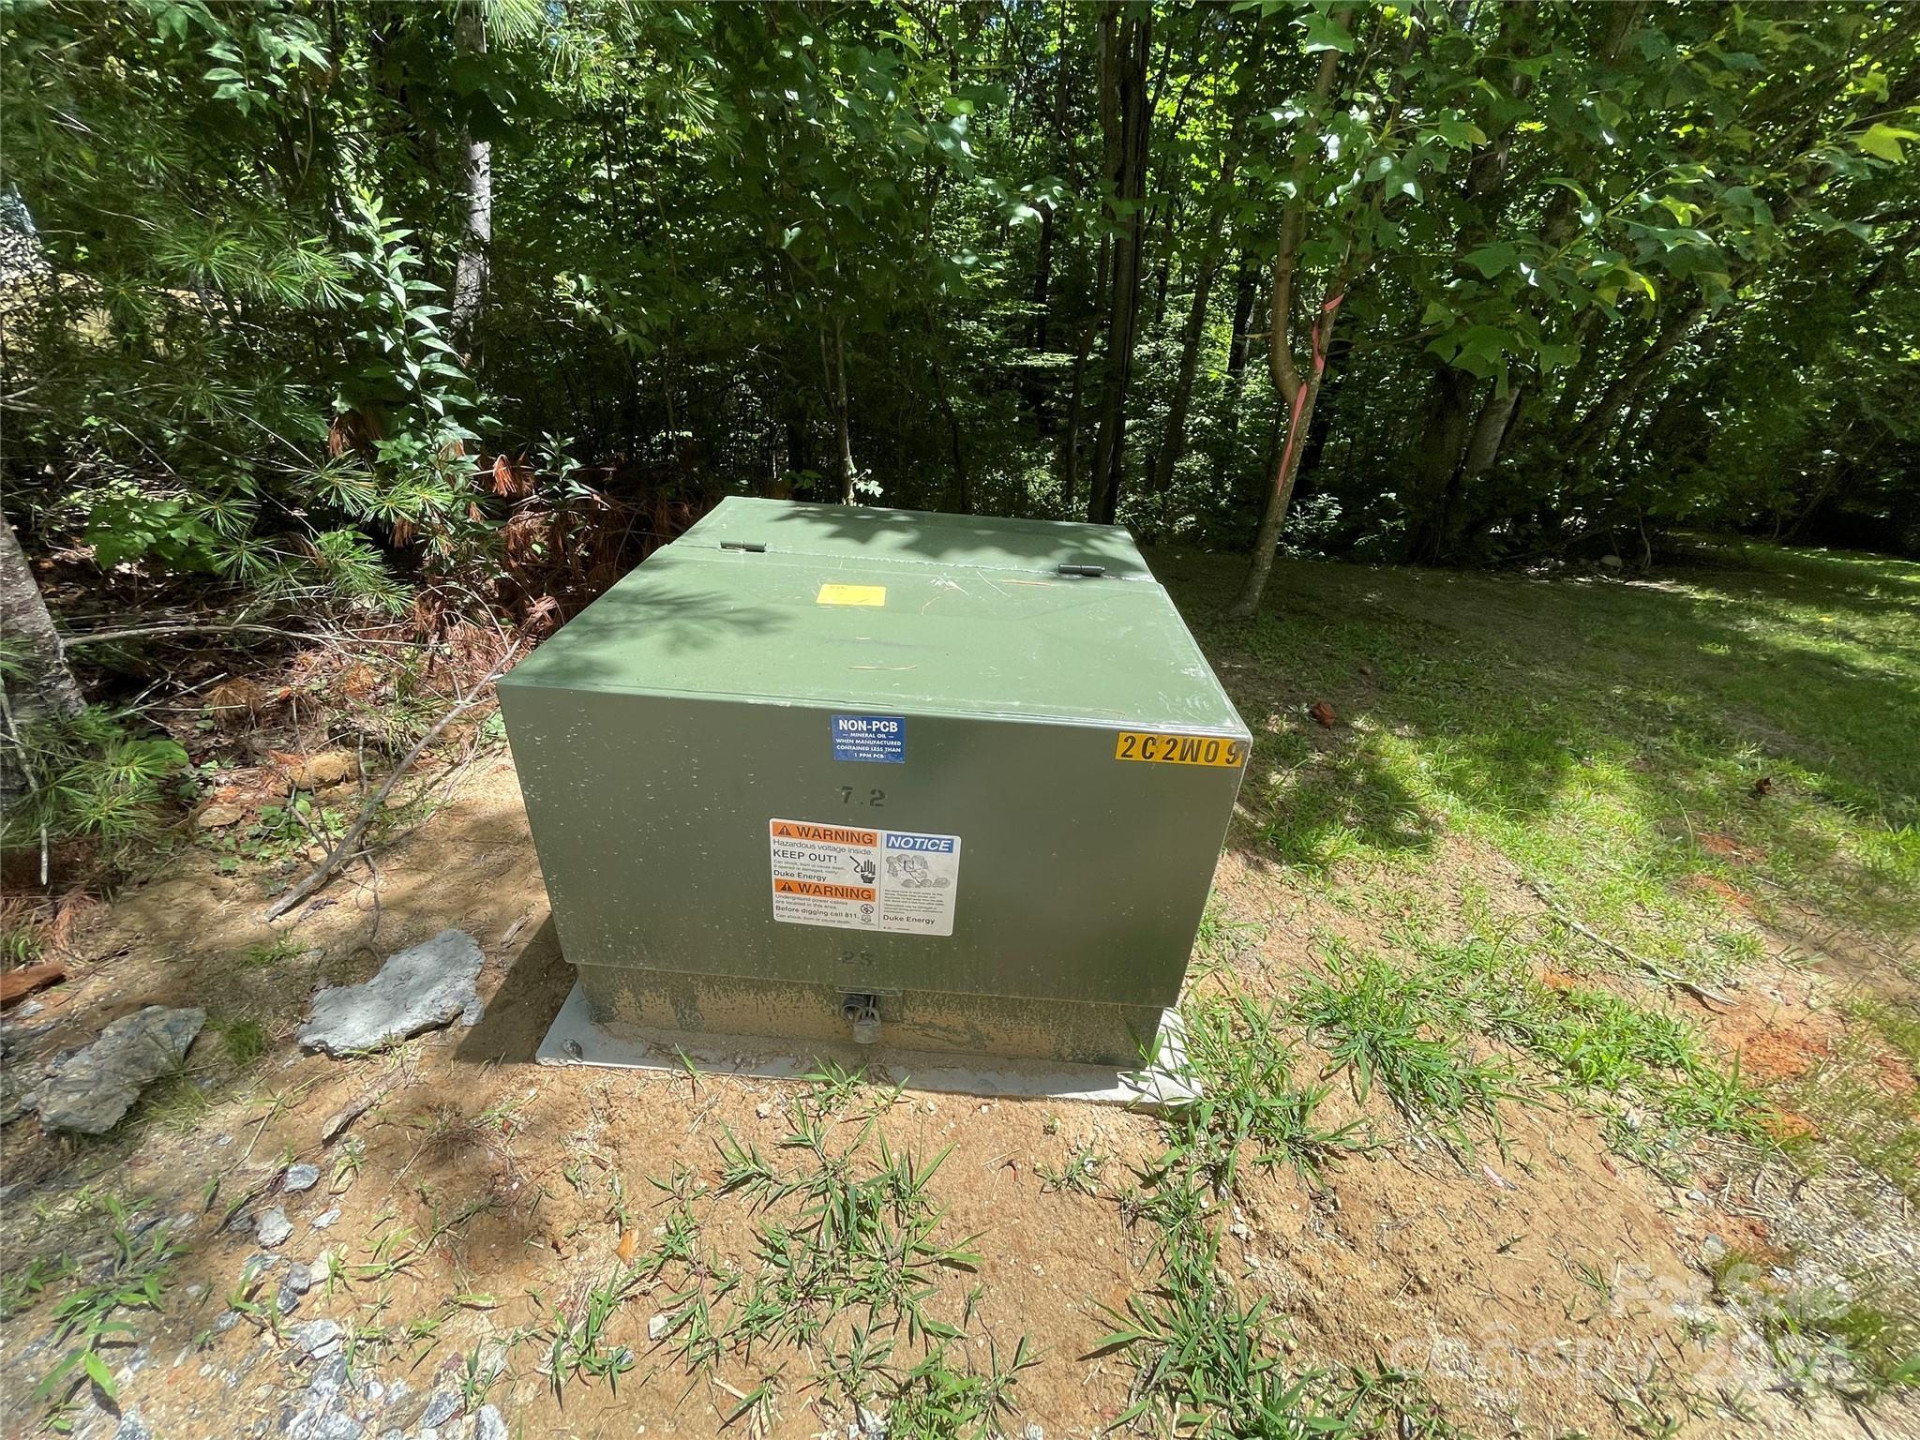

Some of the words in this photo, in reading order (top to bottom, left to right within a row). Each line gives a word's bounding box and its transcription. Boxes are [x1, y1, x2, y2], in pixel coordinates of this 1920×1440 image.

[839, 720, 898, 732] NON-PCB
[797, 826, 872, 844] WARNING
[774, 839, 816, 849] Hazardous
[818, 844, 846, 854] voltage
[888, 836, 951, 851] NOTICE
[773, 849, 804, 859] KEEP
[809, 853, 837, 863] OUT!
[774, 870, 794, 878] Duke
[798, 873, 827, 882] Energy
[798, 883, 872, 900] WARNING
[801, 908, 828, 916] digging
[883, 914, 904, 922] Duke
[906, 916, 935, 925] Energy
